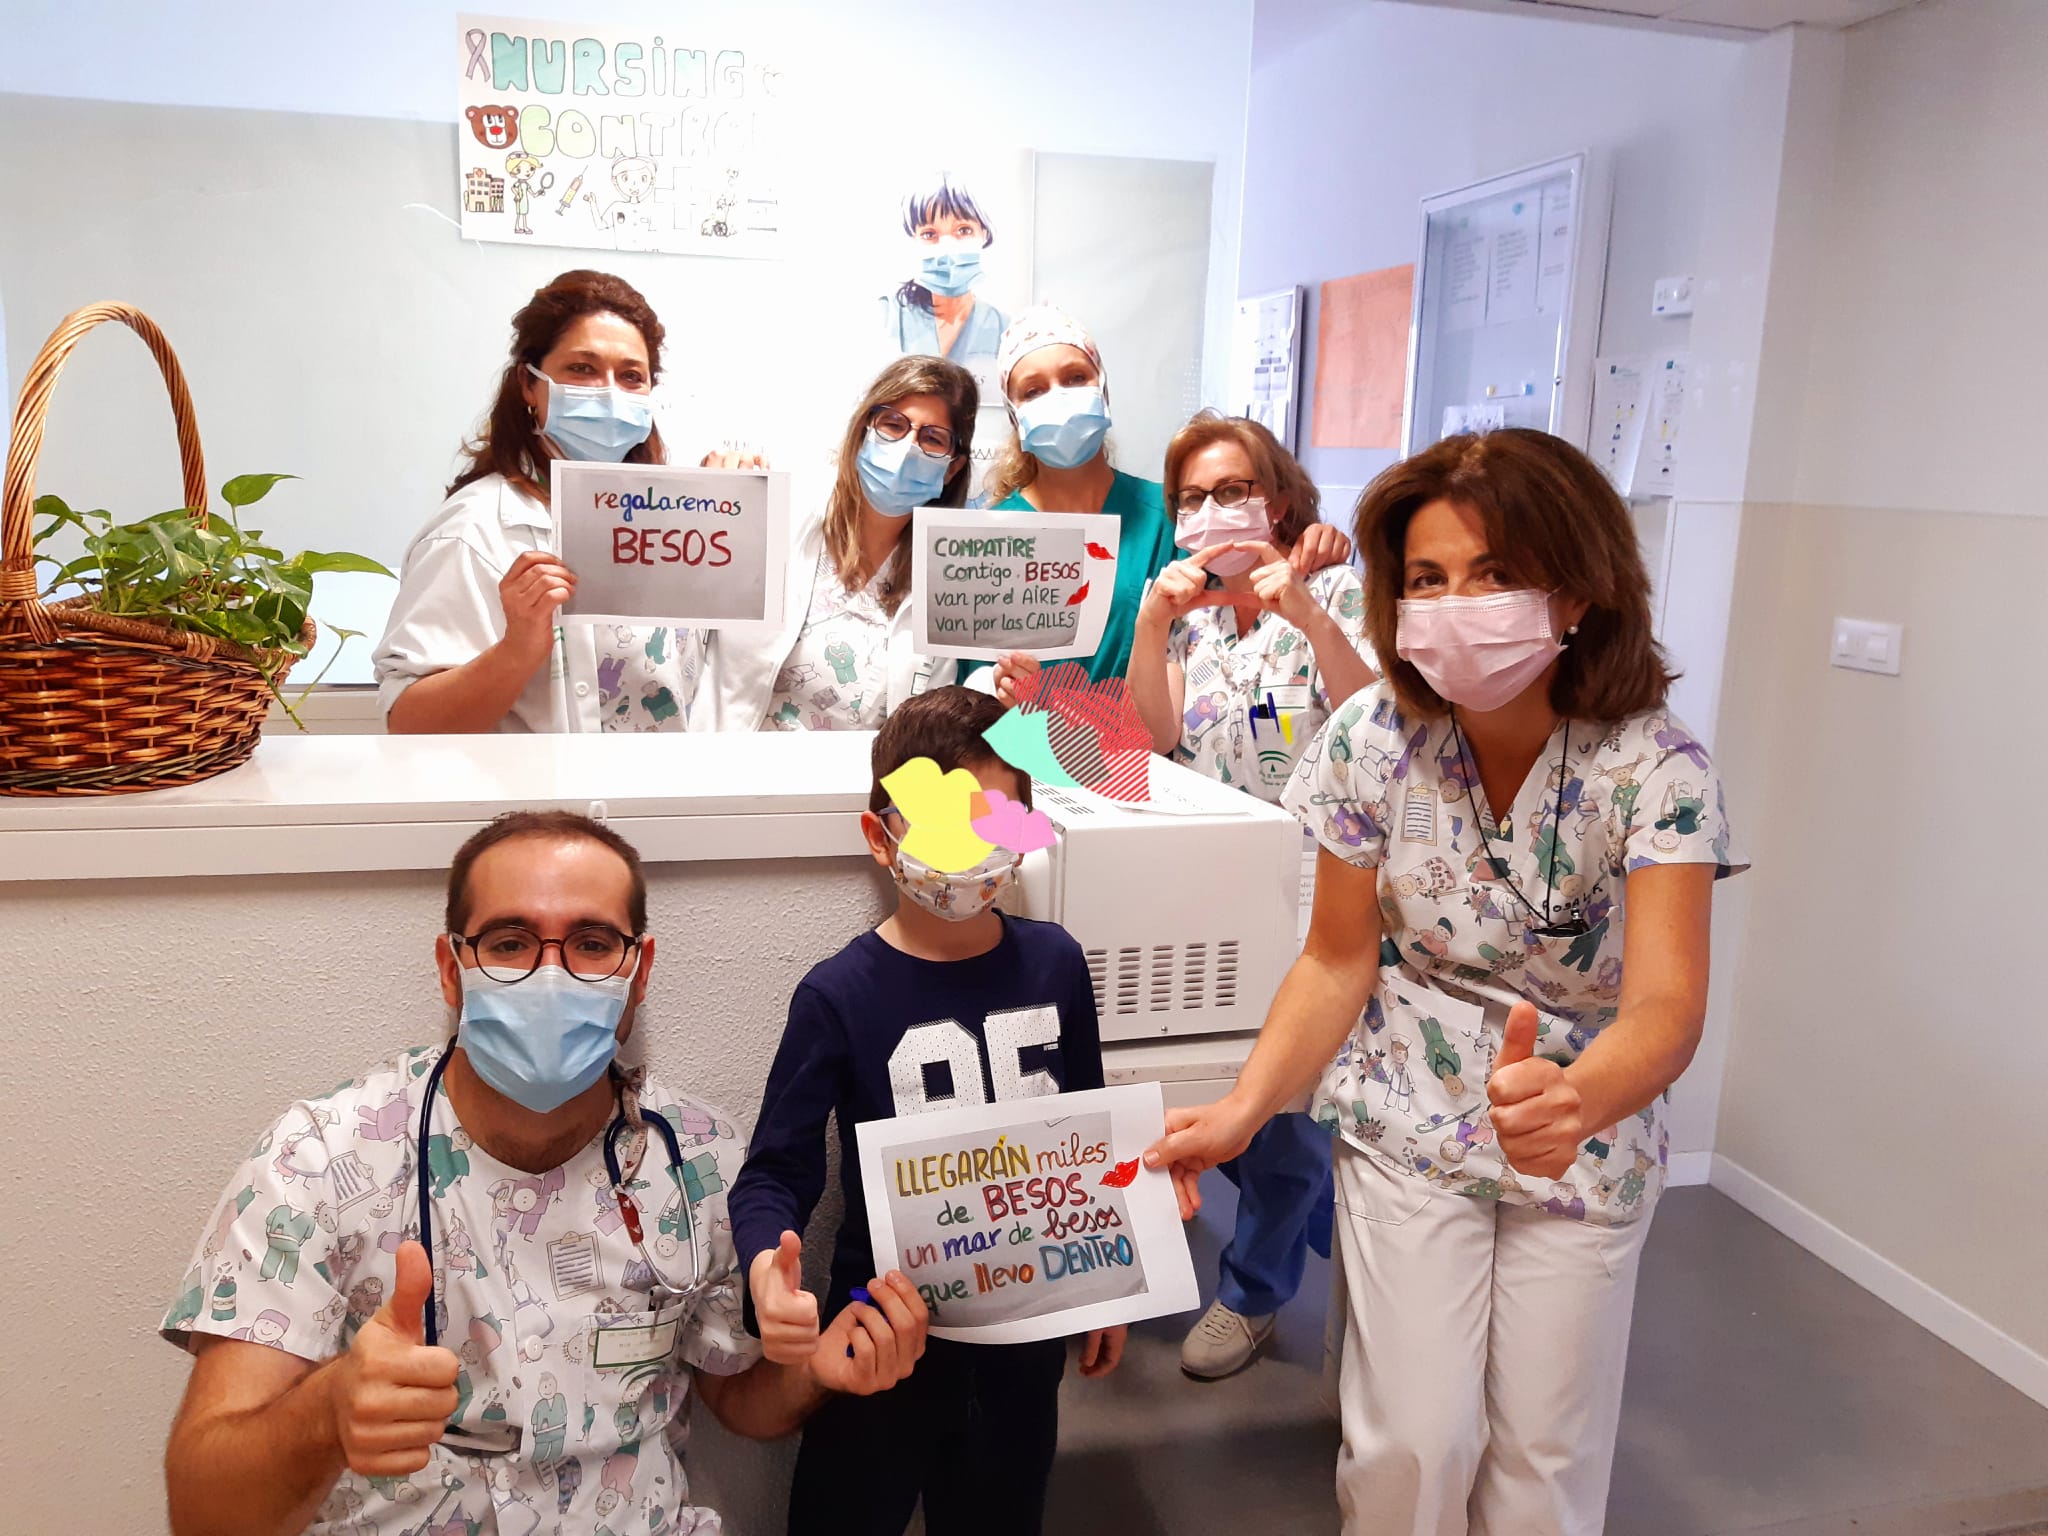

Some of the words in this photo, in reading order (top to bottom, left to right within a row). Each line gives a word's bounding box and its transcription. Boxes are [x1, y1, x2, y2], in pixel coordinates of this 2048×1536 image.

[594, 487, 742, 522] regalaremos
[612, 527, 732, 567] BESOS
[1025, 561, 1081, 582] BESOS
[935, 592, 968, 606] van
[974, 592, 1000, 614] por
[1003, 587, 1014, 604] el
[935, 617, 968, 632] van
[974, 618, 997, 640] por
[1002, 614, 1022, 630] las
[1026, 611, 1075, 629] CALLES
[896, 1135, 1032, 1197] LLEGARÁN
[1036, 1132, 1109, 1174] miles
[937, 1200, 974, 1226] de
[905, 1243, 938, 1269] un
[943, 1228, 1002, 1261] mar
[1008, 1221, 1034, 1245] de
[1041, 1204, 1123, 1240] besos
[918, 1279, 973, 1316] que
[973, 1262, 1034, 1294] llevo
[1039, 1234, 1135, 1282] DENTRO
